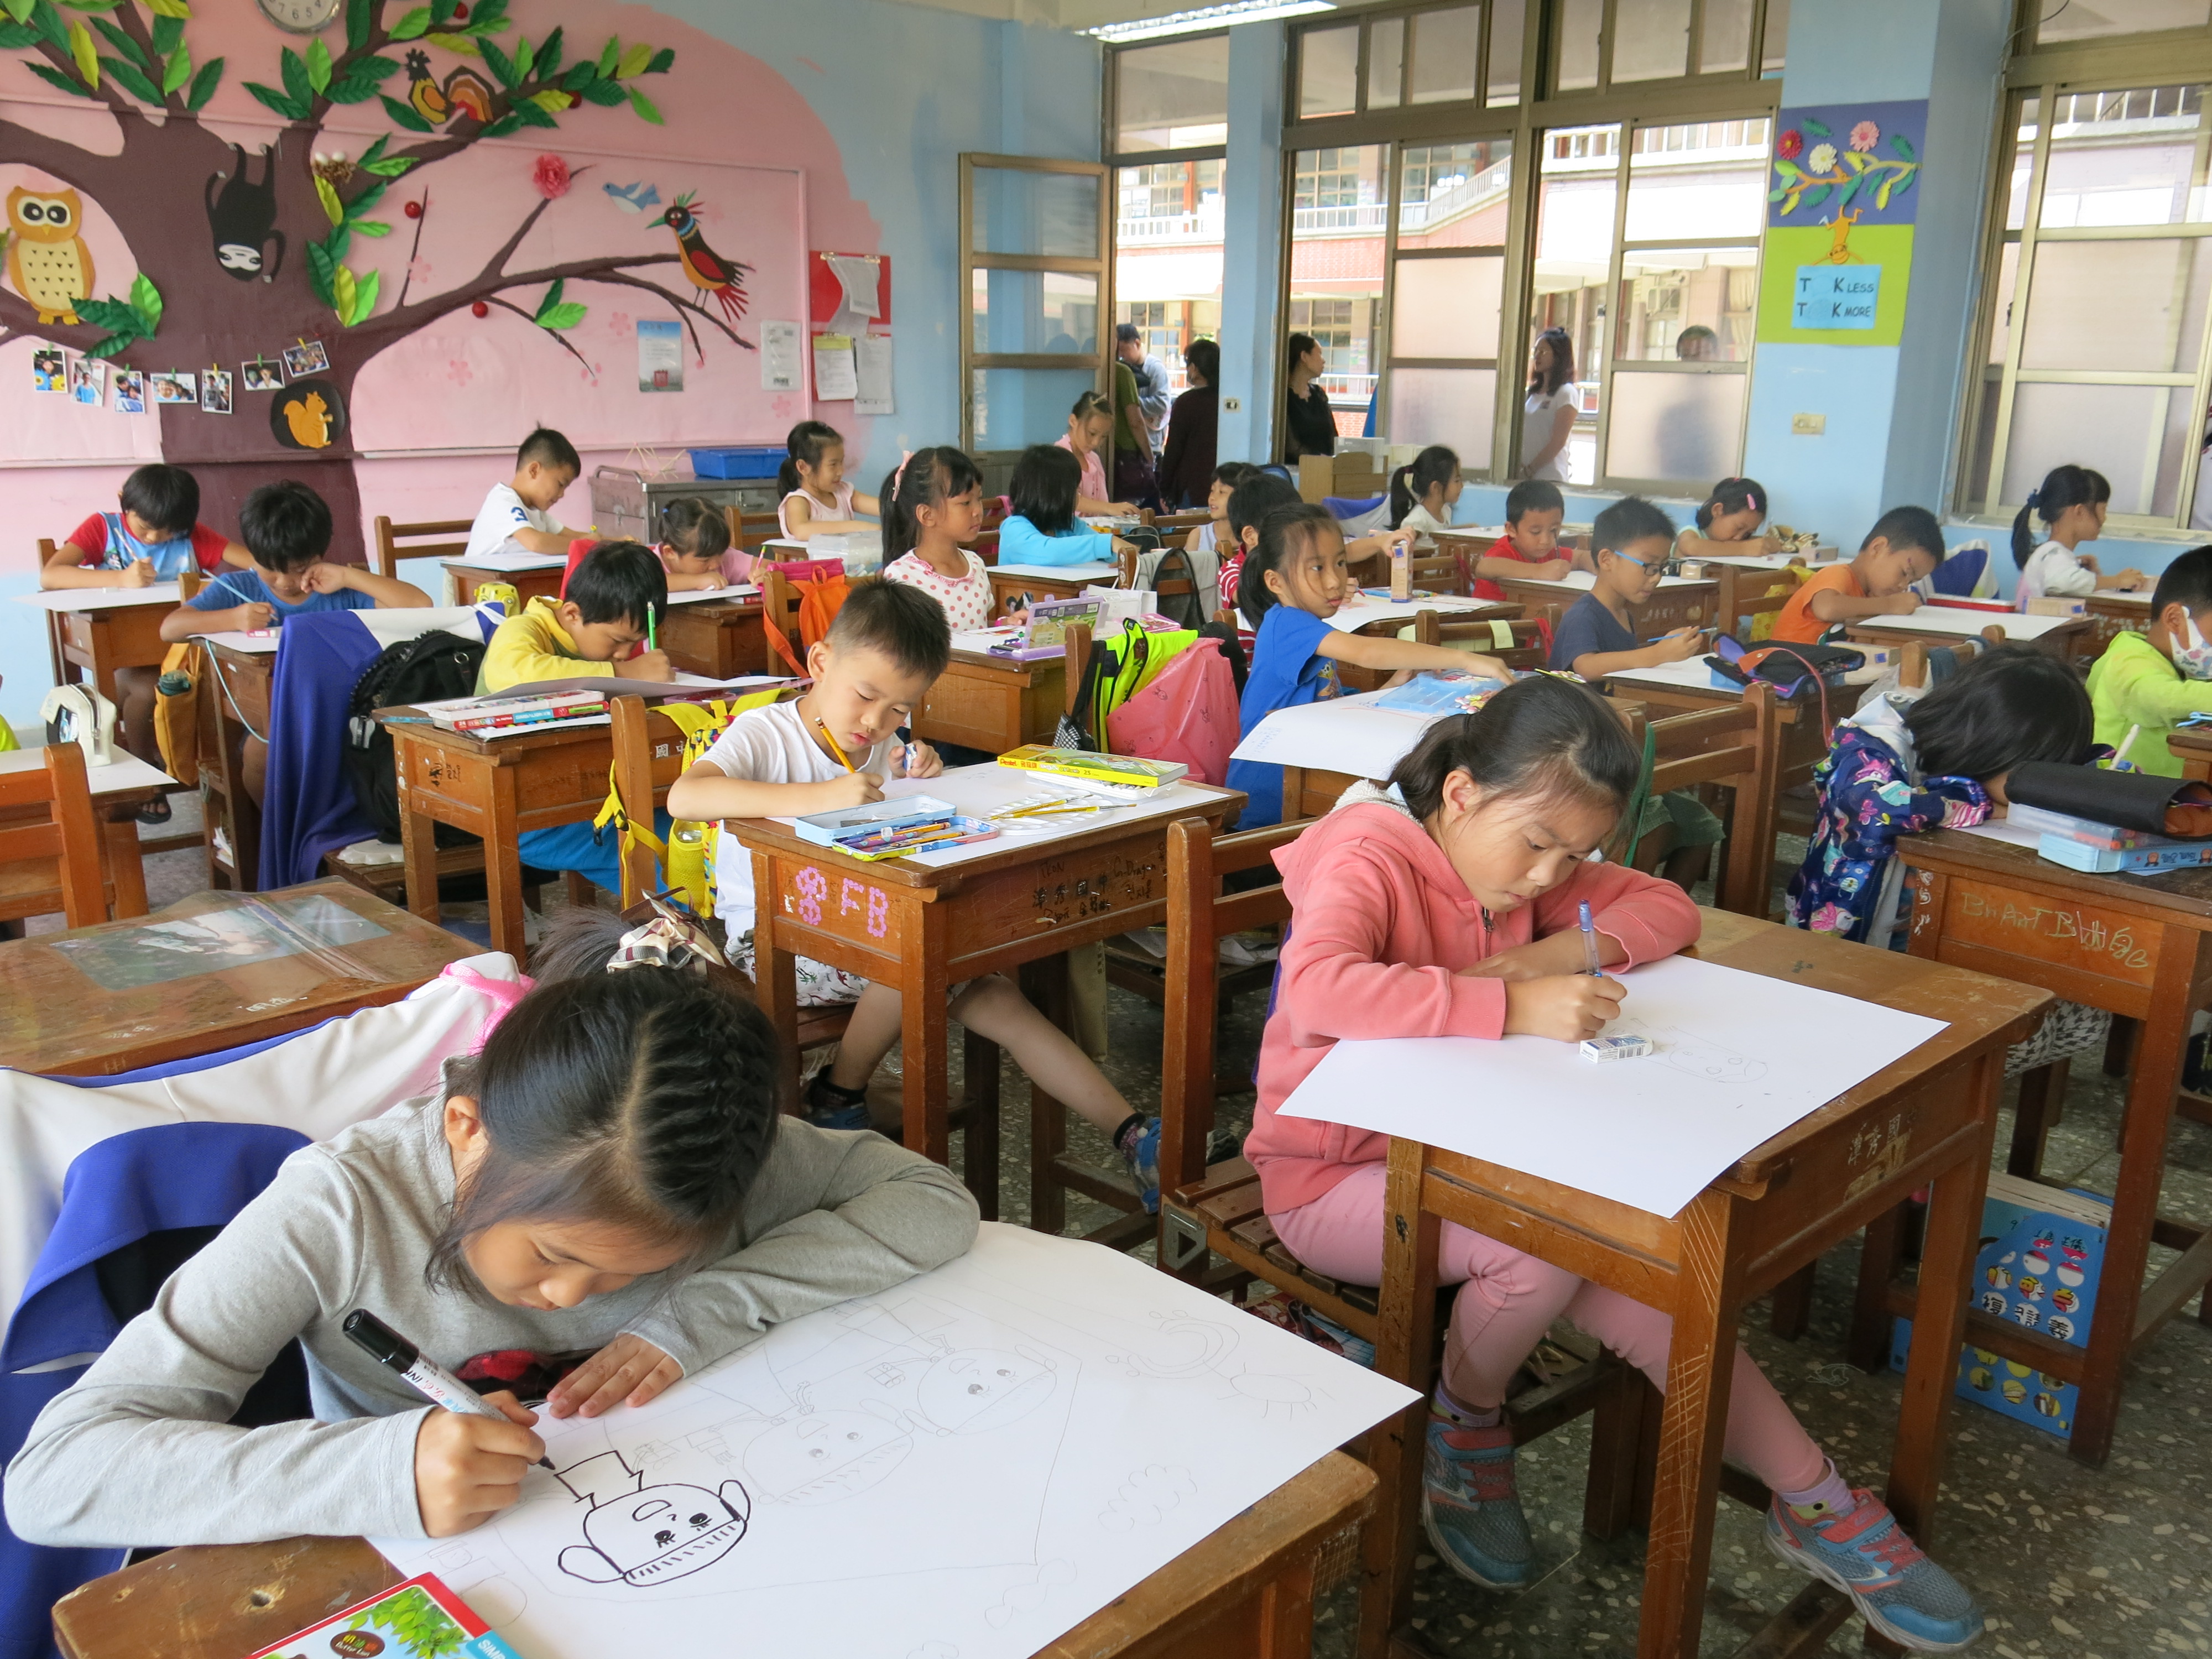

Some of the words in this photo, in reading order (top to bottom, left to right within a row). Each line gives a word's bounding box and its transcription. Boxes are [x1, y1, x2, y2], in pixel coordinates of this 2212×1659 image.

[278, 2, 285, 13] 7
[306, 7, 312, 18] 5
[292, 8, 299, 20] 6
[1847, 283, 1874, 293] LESS
[1844, 306, 1871, 317] MORE
[1000, 758, 1017, 766] Pentel
[1113, 856, 1156, 879] G-Dragon
